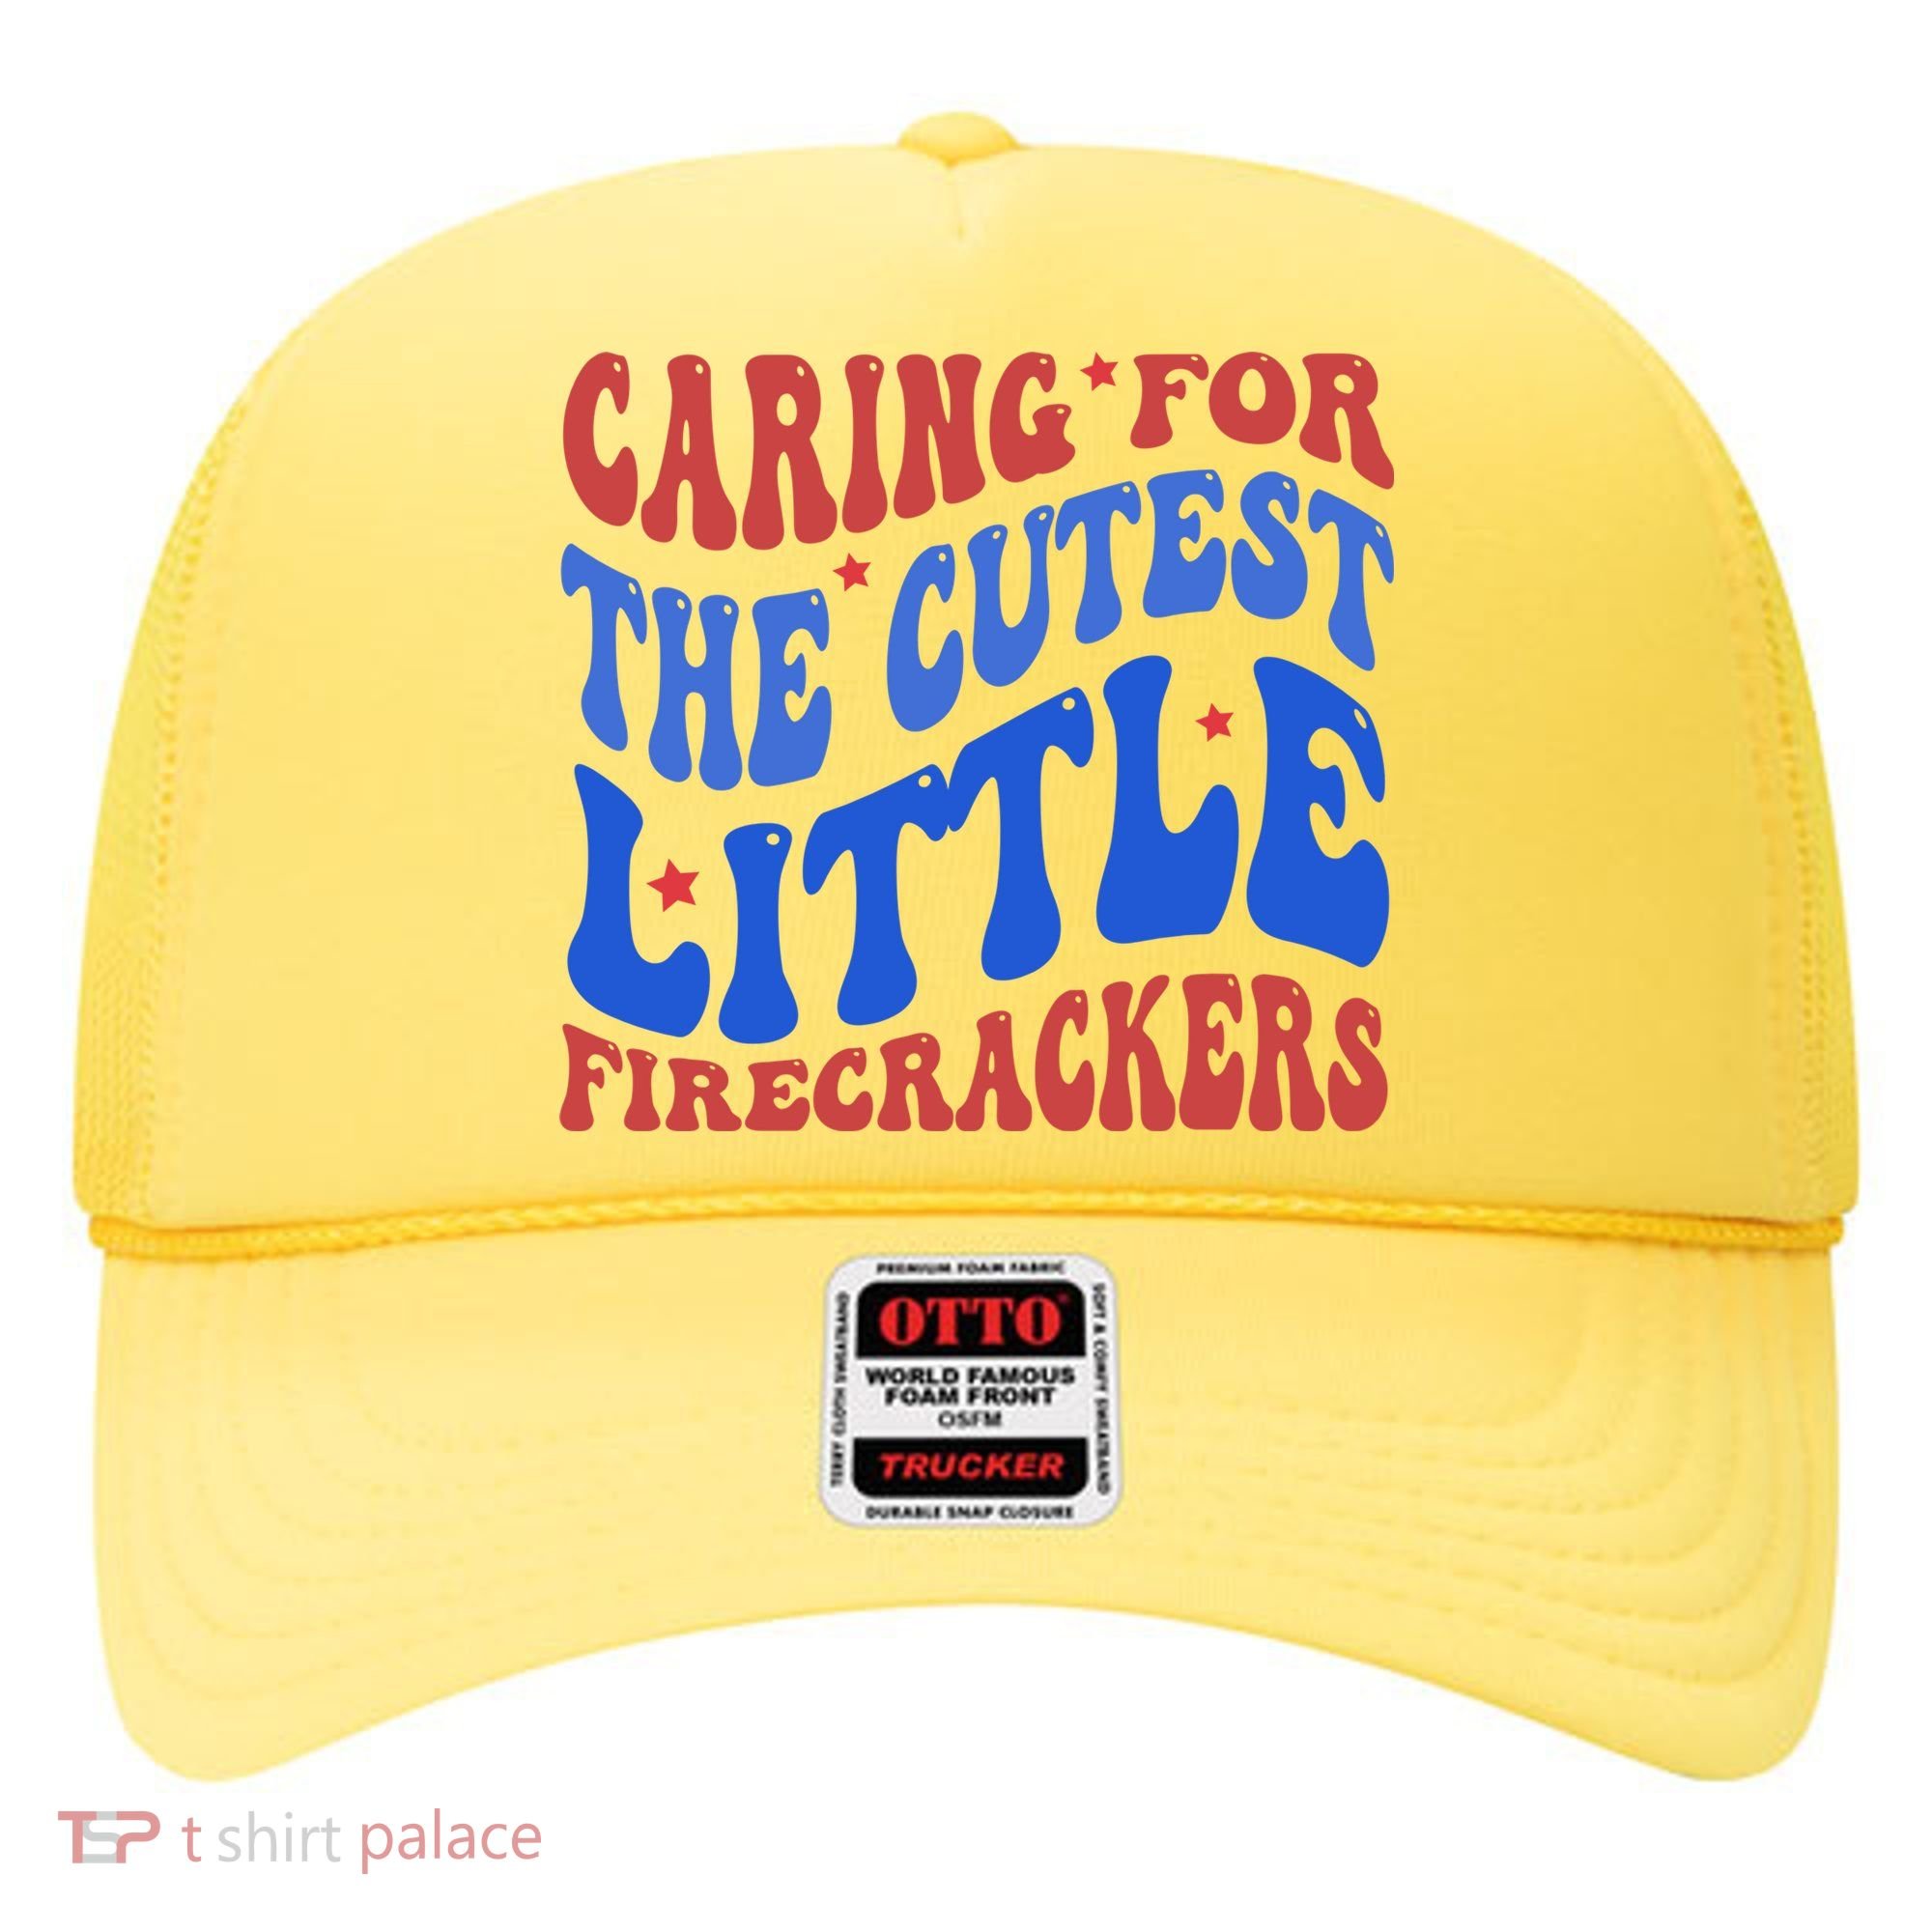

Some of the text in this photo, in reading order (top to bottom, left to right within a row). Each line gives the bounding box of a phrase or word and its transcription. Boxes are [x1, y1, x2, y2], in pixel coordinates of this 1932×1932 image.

[563, 352, 1394, 551] CARING FOR
[561, 469, 1394, 790] THE CUTEST
[568, 656, 1389, 1043] LITTLE
[559, 974, 1388, 1131] FIRECRACKERS
[876, 1261, 1065, 1275] PREMIUM FOAM FABRIC
[879, 1296, 1061, 1346] OTTO
[866, 1367, 1076, 1385] WORLD FAMOUS
[884, 1387, 1057, 1406] FOAM FRONT
[938, 1410, 1002, 1428] OSFM
[880, 1453, 1065, 1479] TRUCKER
[866, 1505, 1073, 1520] DURABLE SNAP CLOSURE
